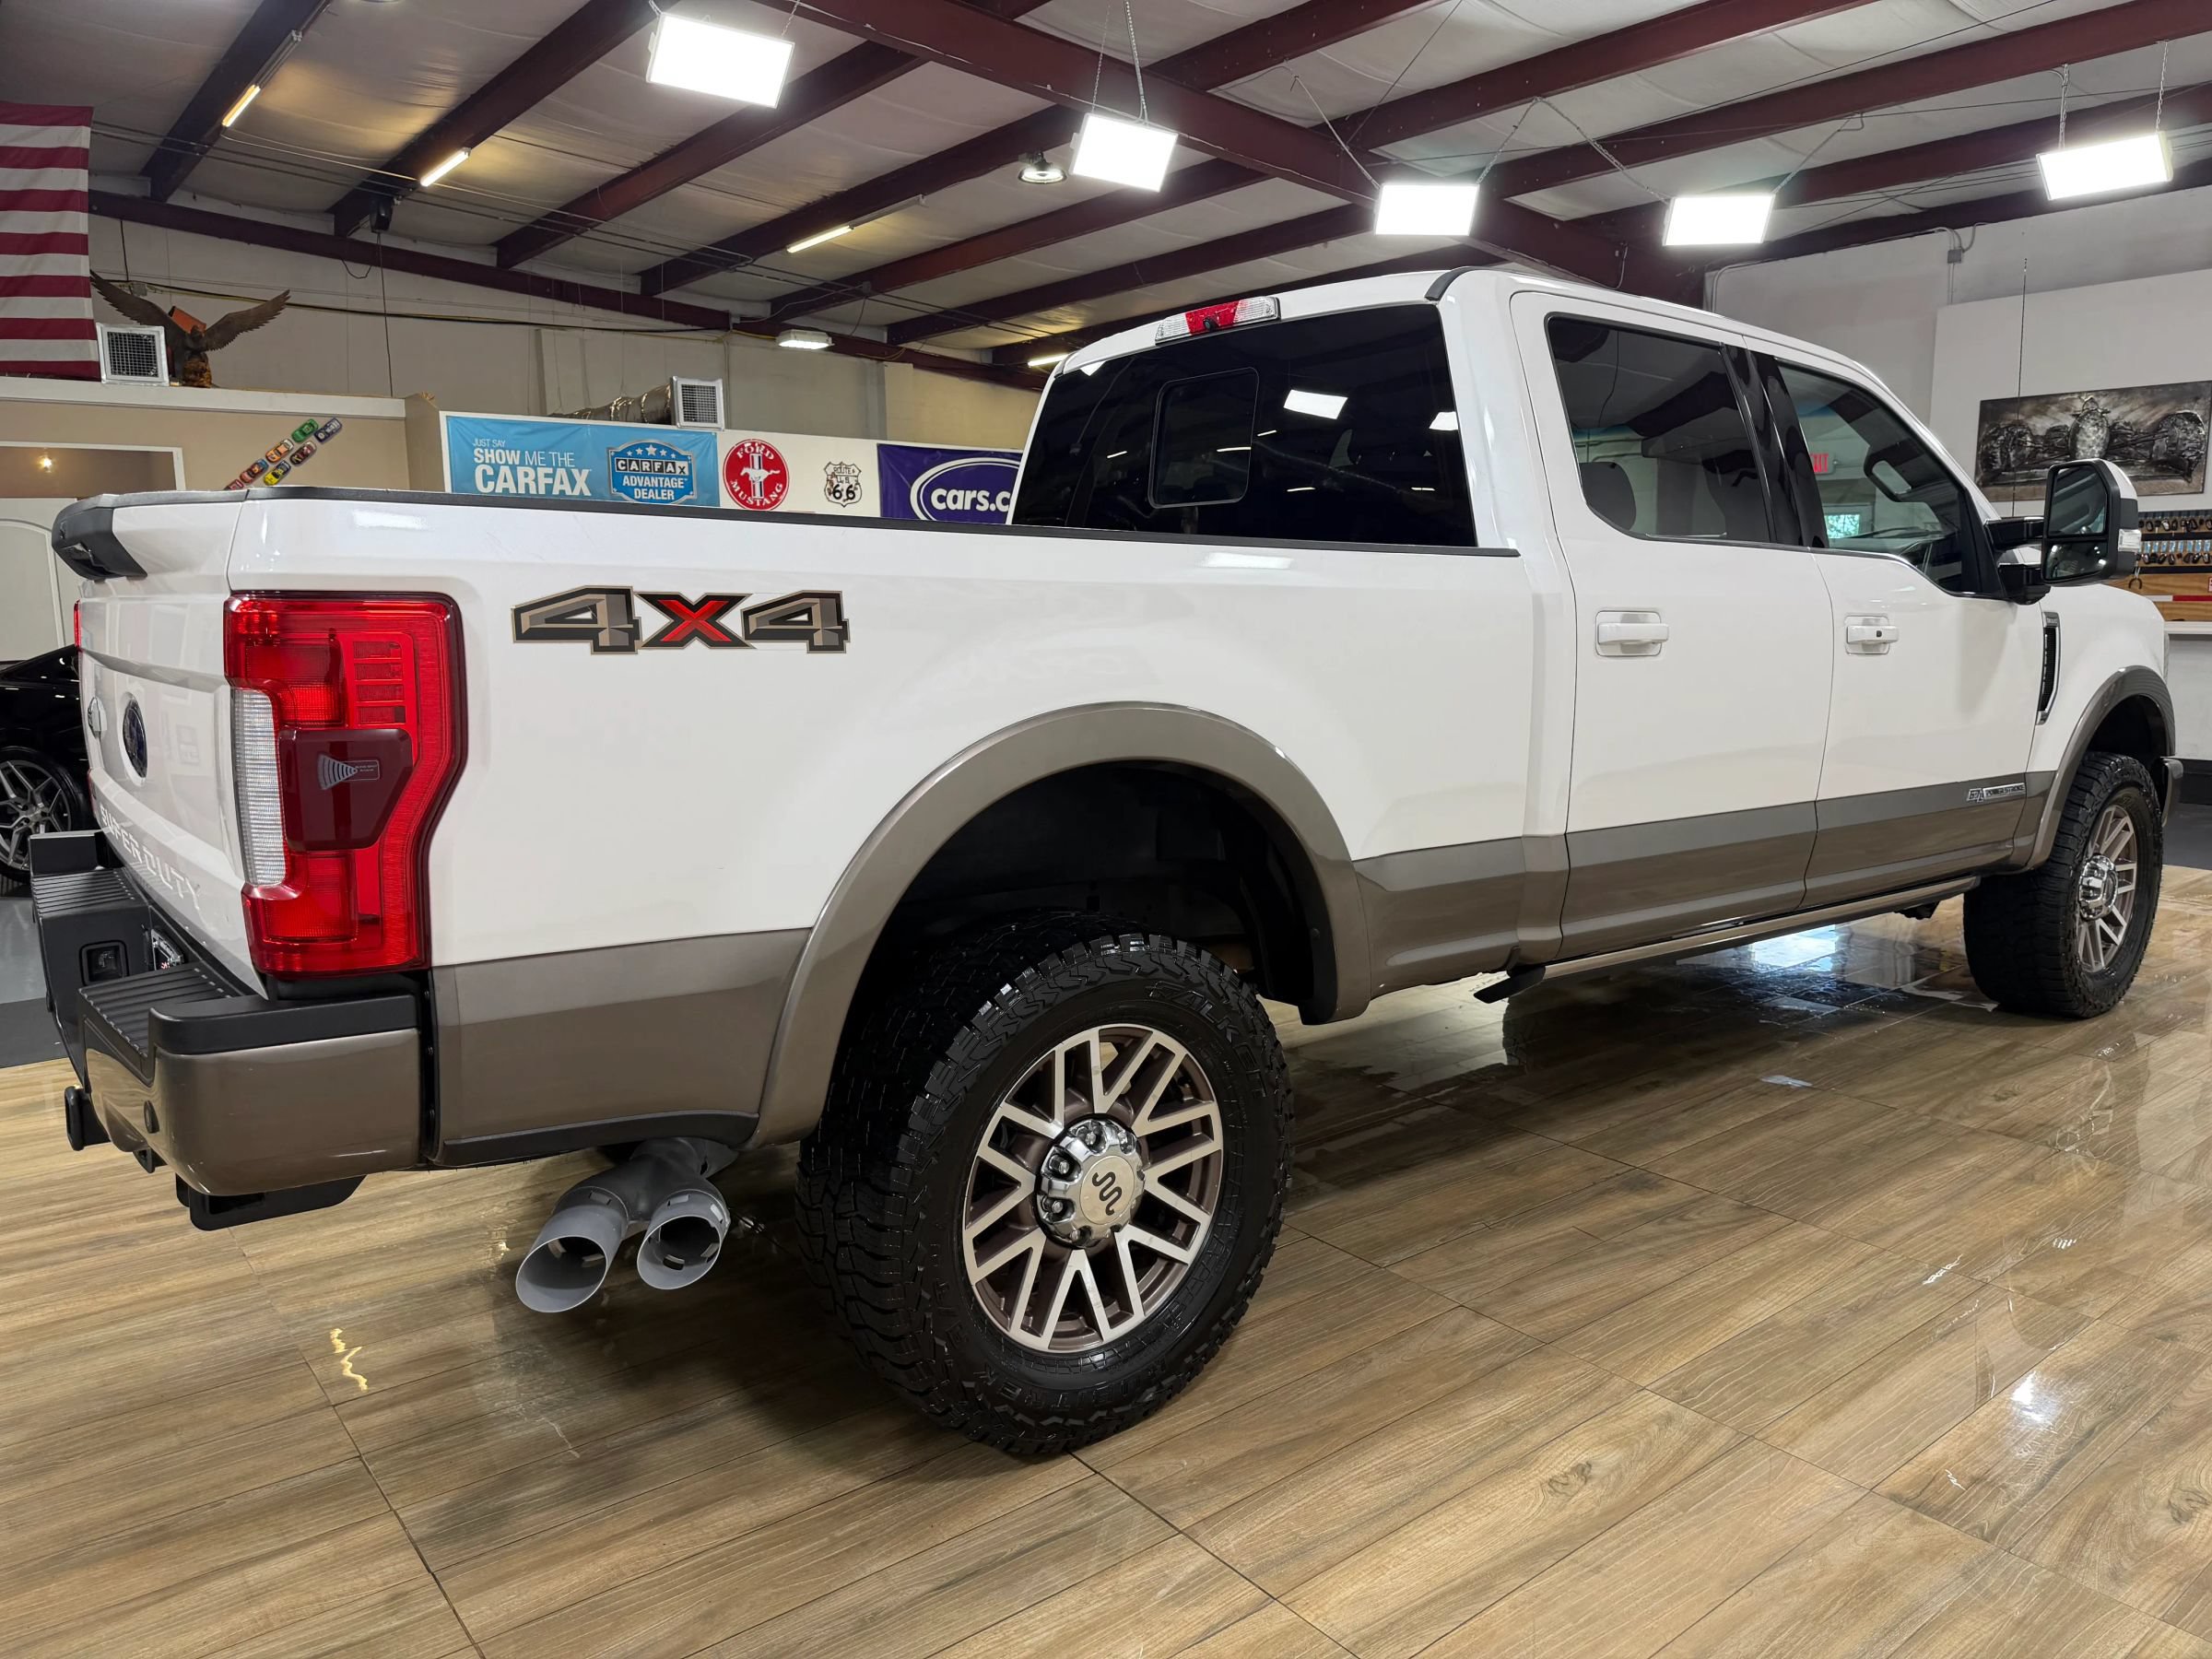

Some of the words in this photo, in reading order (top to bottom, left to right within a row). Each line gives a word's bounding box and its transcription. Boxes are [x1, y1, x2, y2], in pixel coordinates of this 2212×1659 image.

[472, 438, 490, 448] JUST
[491, 439, 506, 448] SAY
[736, 442, 774, 460] FORD
[474, 448, 521, 465] SHOW
[524, 450, 546, 466] ME
[548, 452, 575, 468] THE
[617, 458, 688, 476] CARFAX
[475, 464, 592, 497] CARFAX
[622, 475, 685, 488] ADVANTAGE
[634, 488, 675, 500] DEALER
[730, 479, 783, 507] MUSTANG
[832, 483, 855, 500] 66
[100, 802, 143, 864] SUPER
[143, 845, 200, 911] DUTY
